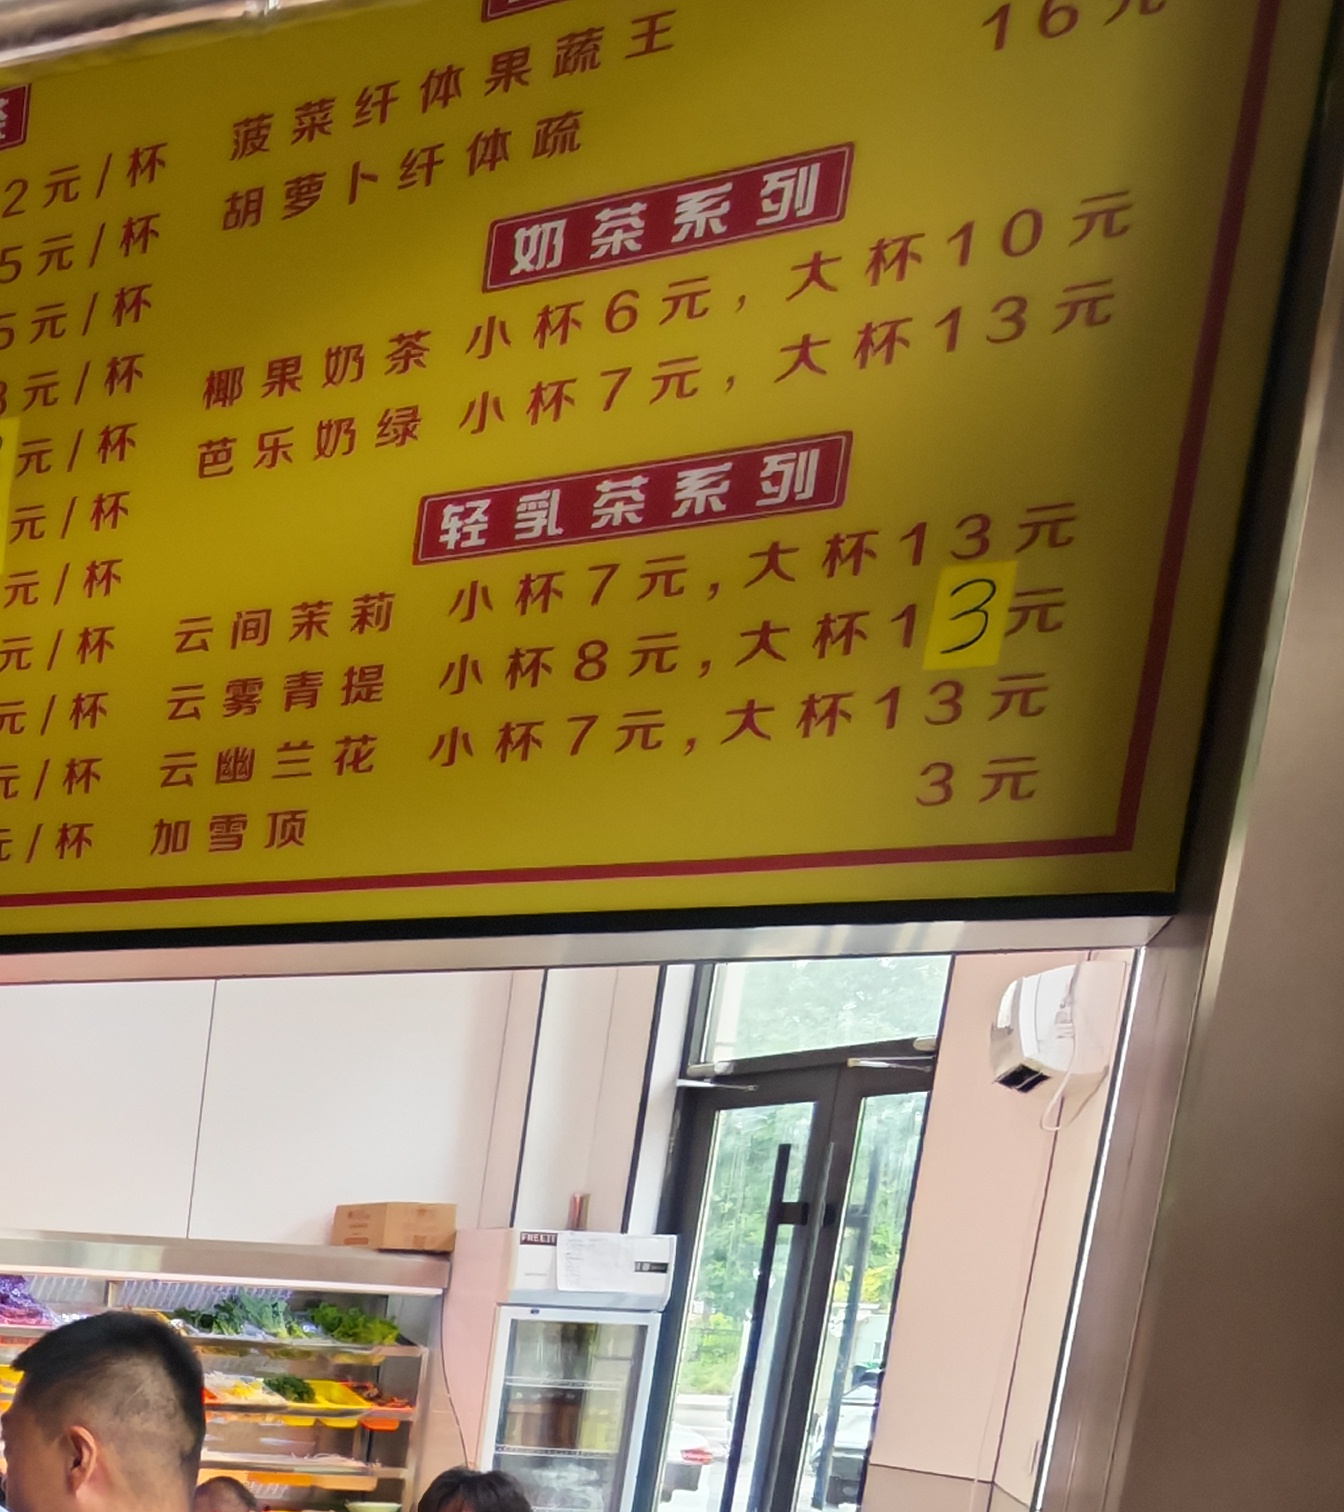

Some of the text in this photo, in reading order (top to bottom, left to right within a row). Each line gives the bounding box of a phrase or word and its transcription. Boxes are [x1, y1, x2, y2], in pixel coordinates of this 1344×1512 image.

[229, 10, 676, 162] 菠菜纤体果蔬王
[1, 142, 168, 219] 2元/杯
[510, 162, 822, 276] 奶茶系列
[203, 330, 432, 411] 椰果奶茶
[196, 404, 423, 480] 芭乐奶绿
[438, 448, 820, 551] 轻乳茶系列
[173, 591, 395, 655] 云间茉莉
[166, 664, 385, 721] 云雾青提
[159, 734, 378, 790] 云幽兰花
[151, 755, 1040, 858] 加雪顶 3元
